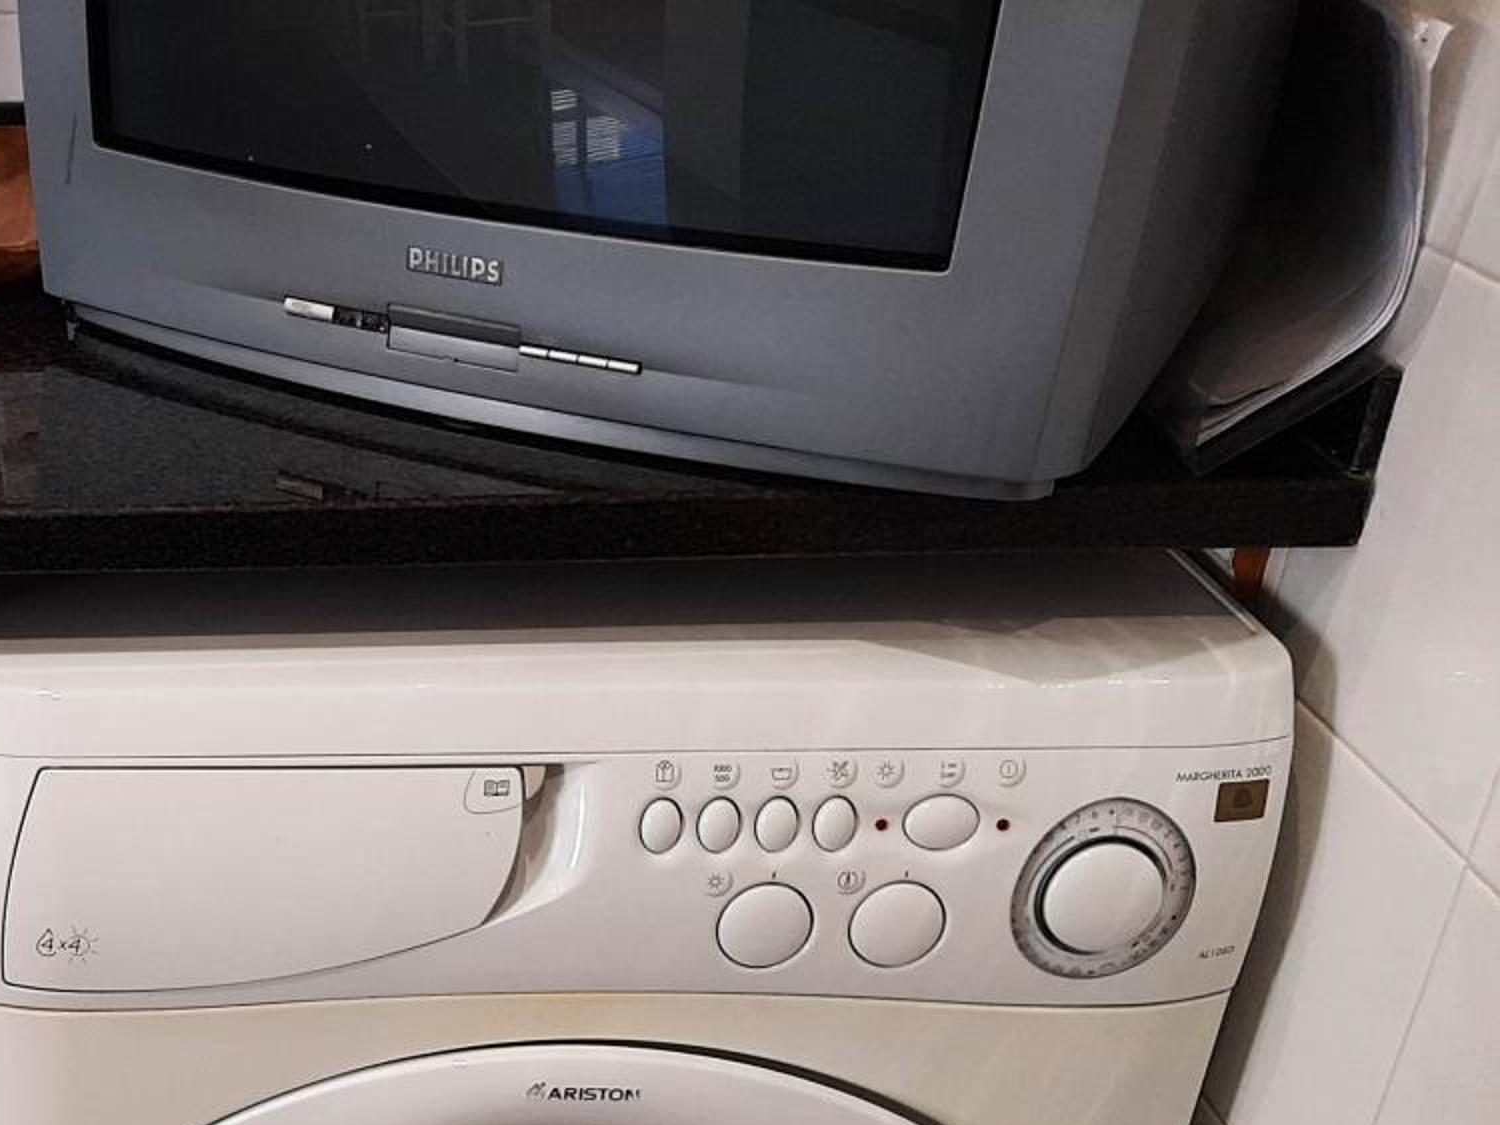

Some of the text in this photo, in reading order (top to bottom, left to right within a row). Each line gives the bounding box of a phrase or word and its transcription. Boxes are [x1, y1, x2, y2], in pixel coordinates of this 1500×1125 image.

[407, 247, 501, 283] PHILIPS
[1176, 765, 1272, 782] MARGHERITA 2000
[547, 1087, 641, 1101] ARISTON
